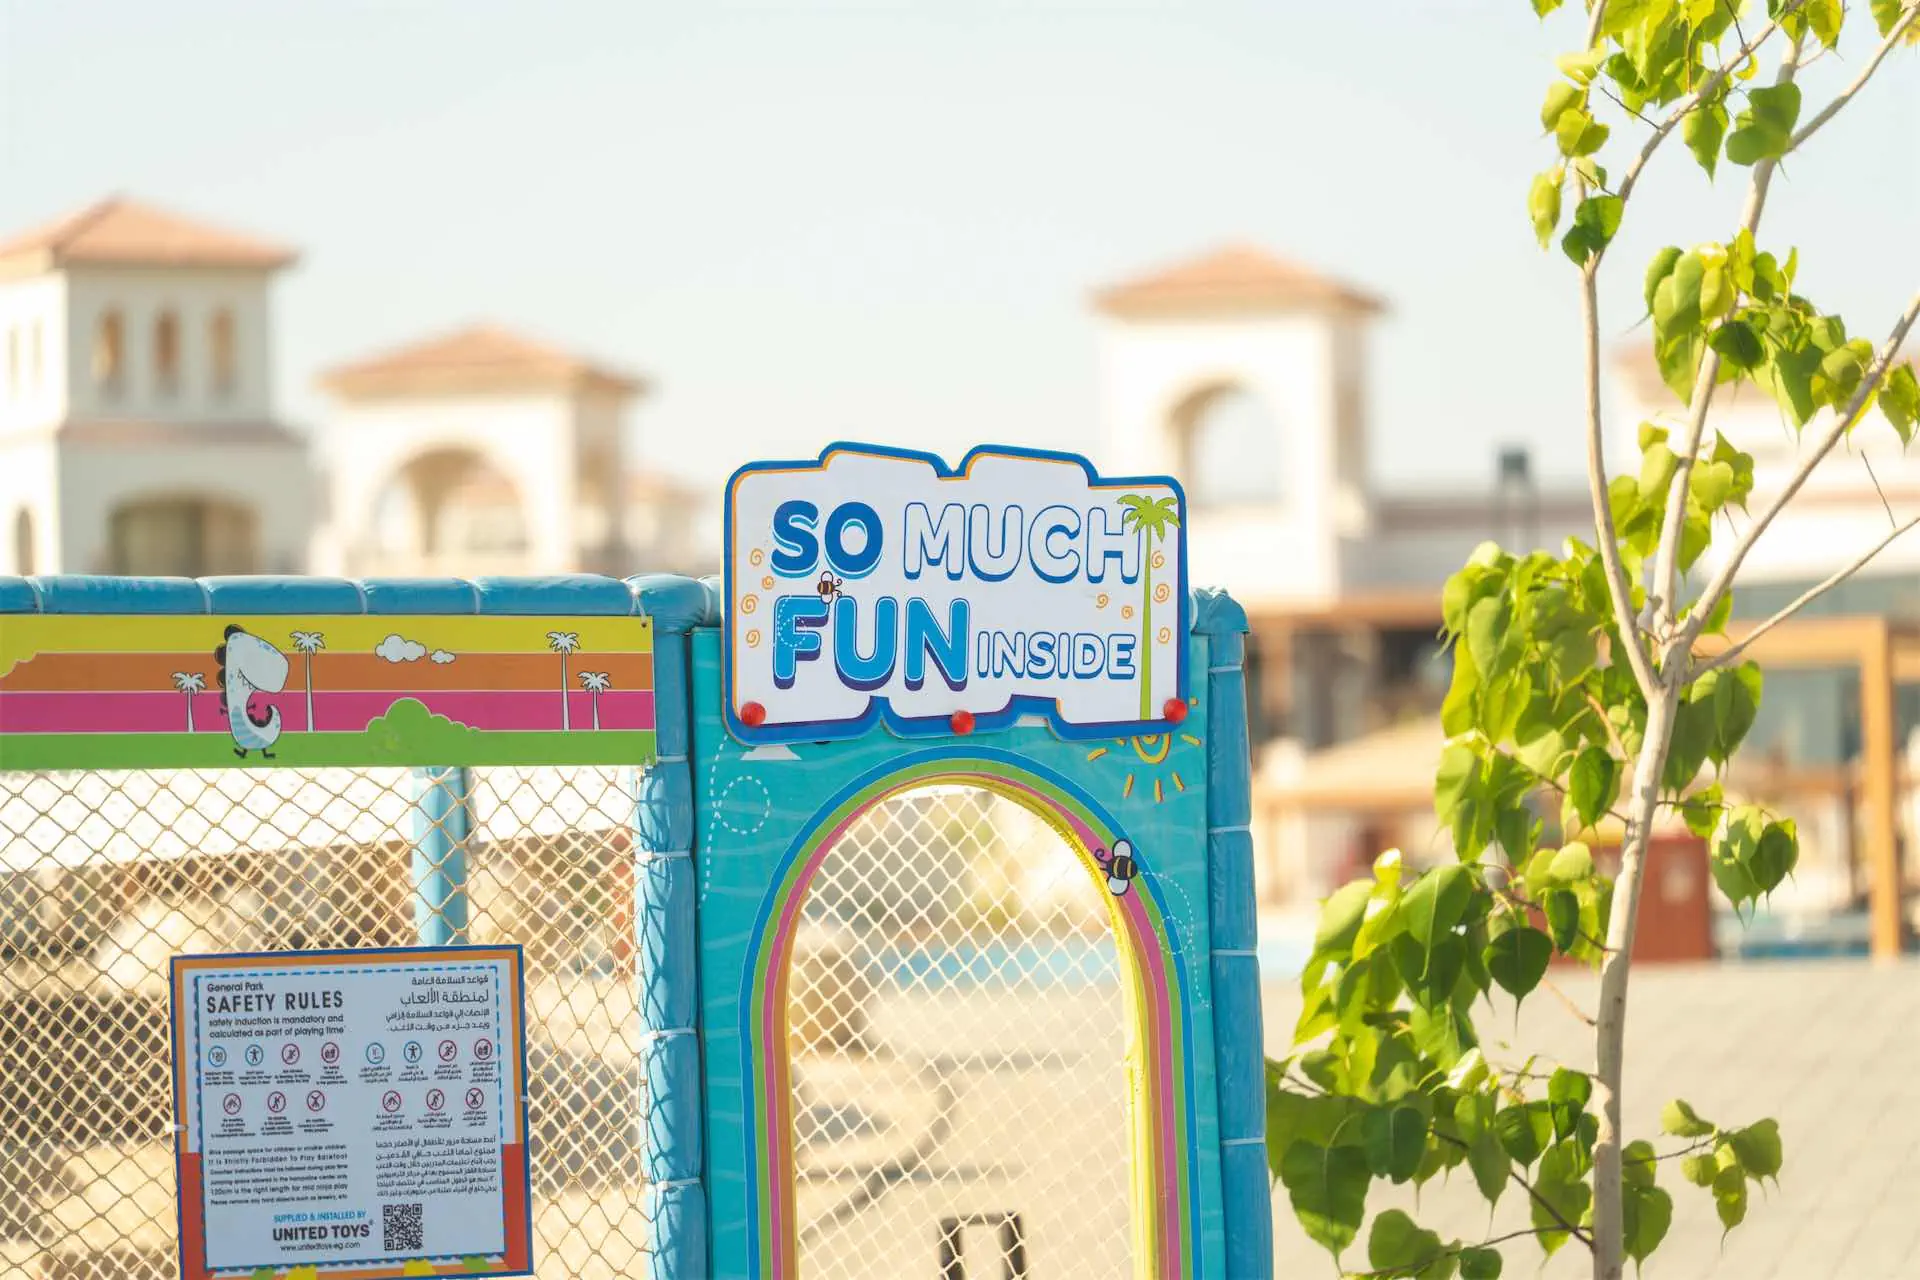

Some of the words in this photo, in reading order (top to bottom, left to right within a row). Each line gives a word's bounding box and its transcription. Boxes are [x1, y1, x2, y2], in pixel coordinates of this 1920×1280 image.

[770, 499, 885, 580] SO
[903, 502, 1141, 585] MUCH
[772, 594, 970, 691] FUN
[976, 631, 1137, 680] INSIDE
[207, 982, 243, 992] General
[245, 981, 264, 991] Park
[436, 976, 465, 985] السلامة
[467, 975, 488, 986] قواعد
[207, 993, 276, 1014] SAFETY
[285, 991, 344, 1010] RULES
[400, 988, 440, 1007] الألعاب
[442, 989, 489, 1004] لمنطقة
[234, 1016, 272, 1026] induction
[274, 1016, 280, 1024] is
[282, 1014, 326, 1025] mandatory
[328, 1014, 344, 1022] and
[209, 1028, 252, 1038] calculated
[266, 1028, 282, 1038] part
[285, 1027, 293, 1036] of
[294, 1026, 324, 1037] playing
[274, 1213, 308, 1224] SUPPLIED
[310, 1212, 316, 1220] &
[317, 1211, 356, 1220] INSTALLED
[357, 1210, 368, 1219] BY
[272, 1226, 328, 1241] UNITED
